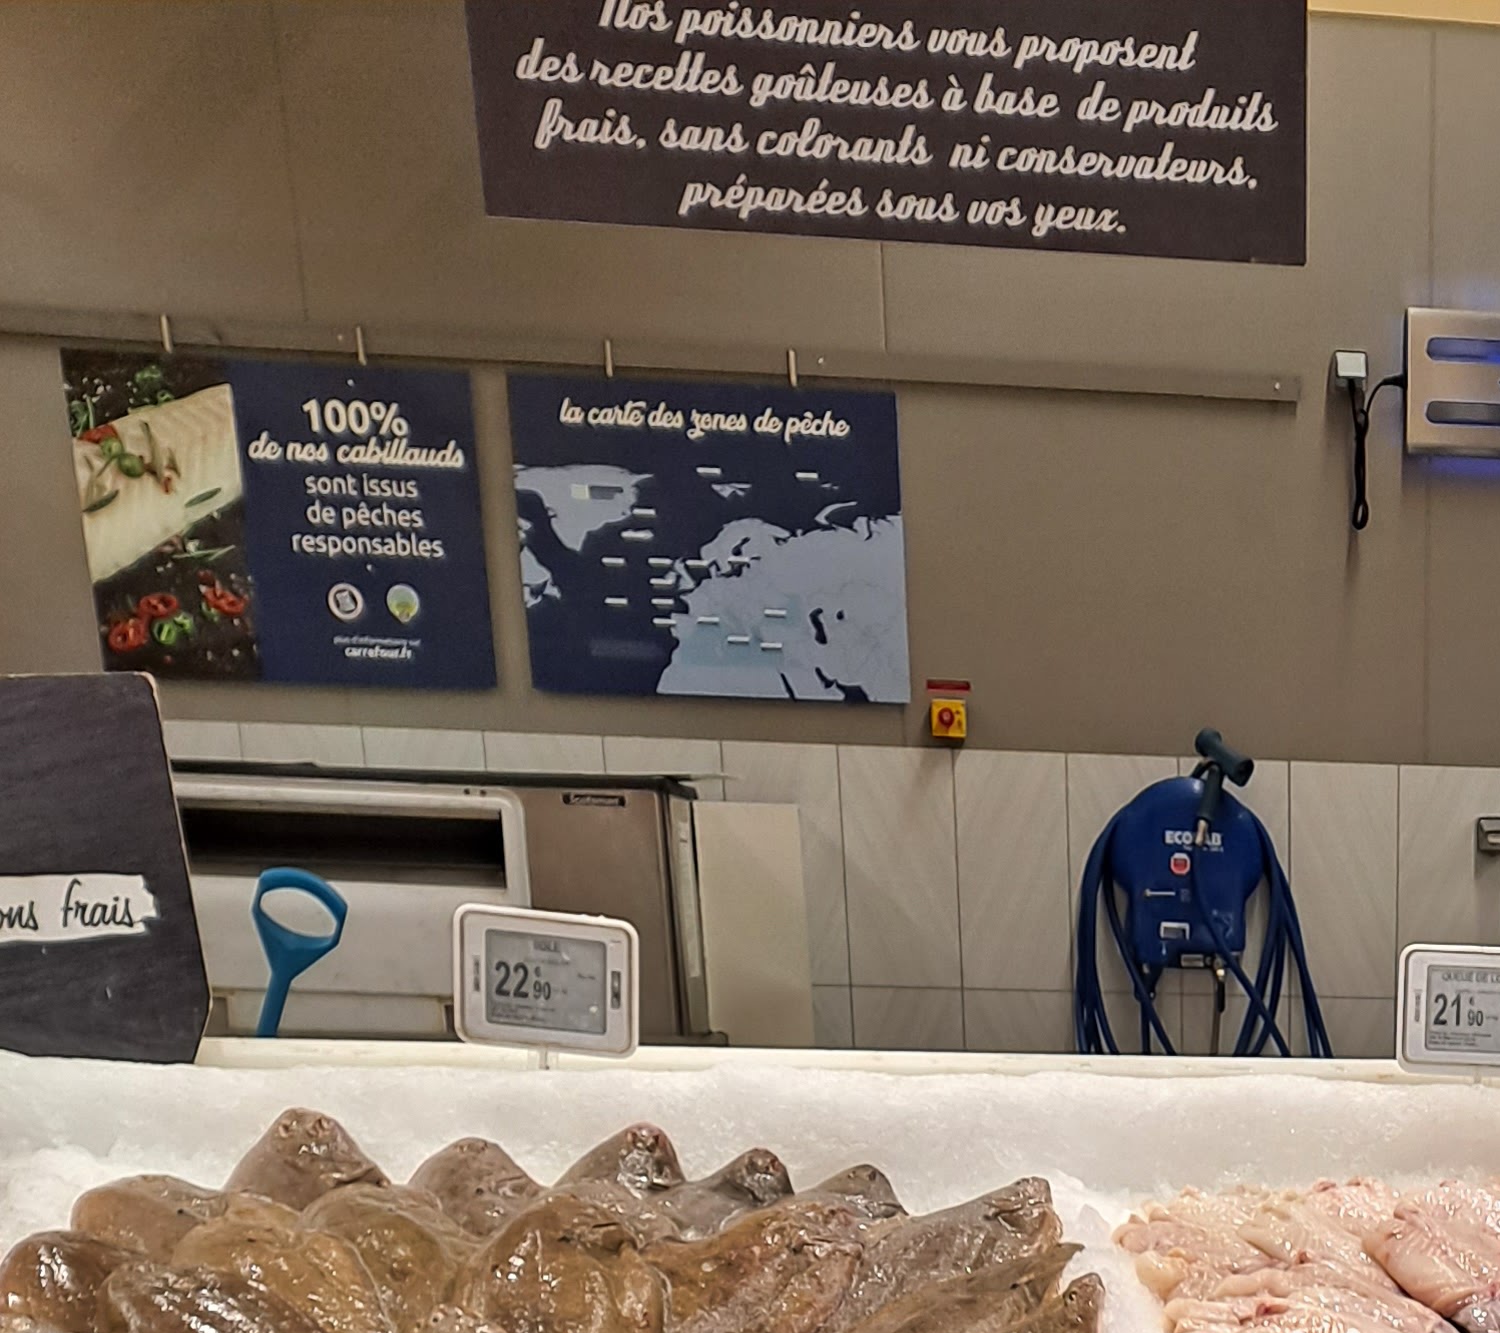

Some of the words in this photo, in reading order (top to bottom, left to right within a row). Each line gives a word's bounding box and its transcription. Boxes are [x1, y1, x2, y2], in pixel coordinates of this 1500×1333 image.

[599, 0, 672, 31] Nos
[675, 1, 920, 50] poissonniers
[927, 27, 1011, 57] vous
[1014, 30, 1199, 73] proposent
[515, 37, 584, 82] des
[590, 51, 744, 95] recettes
[749, 60, 934, 109] goûteuses
[941, 74, 967, 111] à
[973, 72, 1060, 117] base
[1077, 81, 1121, 121] de
[1122, 87, 1278, 132] produits
[659, 118, 749, 153] sans
[756, 117, 933, 165] colorants
[949, 134, 990, 167] ni
[678, 173, 868, 219] préparées
[875, 188, 959, 222] sous
[967, 197, 1027, 226] vos
[1031, 202, 1126, 237] yeux.
[302, 399, 409, 436] 100%
[560, 398, 585, 424] la
[587, 401, 646, 426] carte
[648, 399, 683, 429] des
[687, 412, 748, 440] zones
[753, 408, 782, 434] de
[784, 411, 850, 443] pêche
[248, 431, 282, 460] de
[286, 441, 329, 462] nos
[336, 437, 465, 468] cabillauds
[305, 474, 357, 496] sont
[363, 474, 418, 498] issus
[306, 502, 336, 525] de
[342, 502, 423, 529] pêches
[291, 533, 445, 558] responsables
[61, 878, 134, 928] frais
